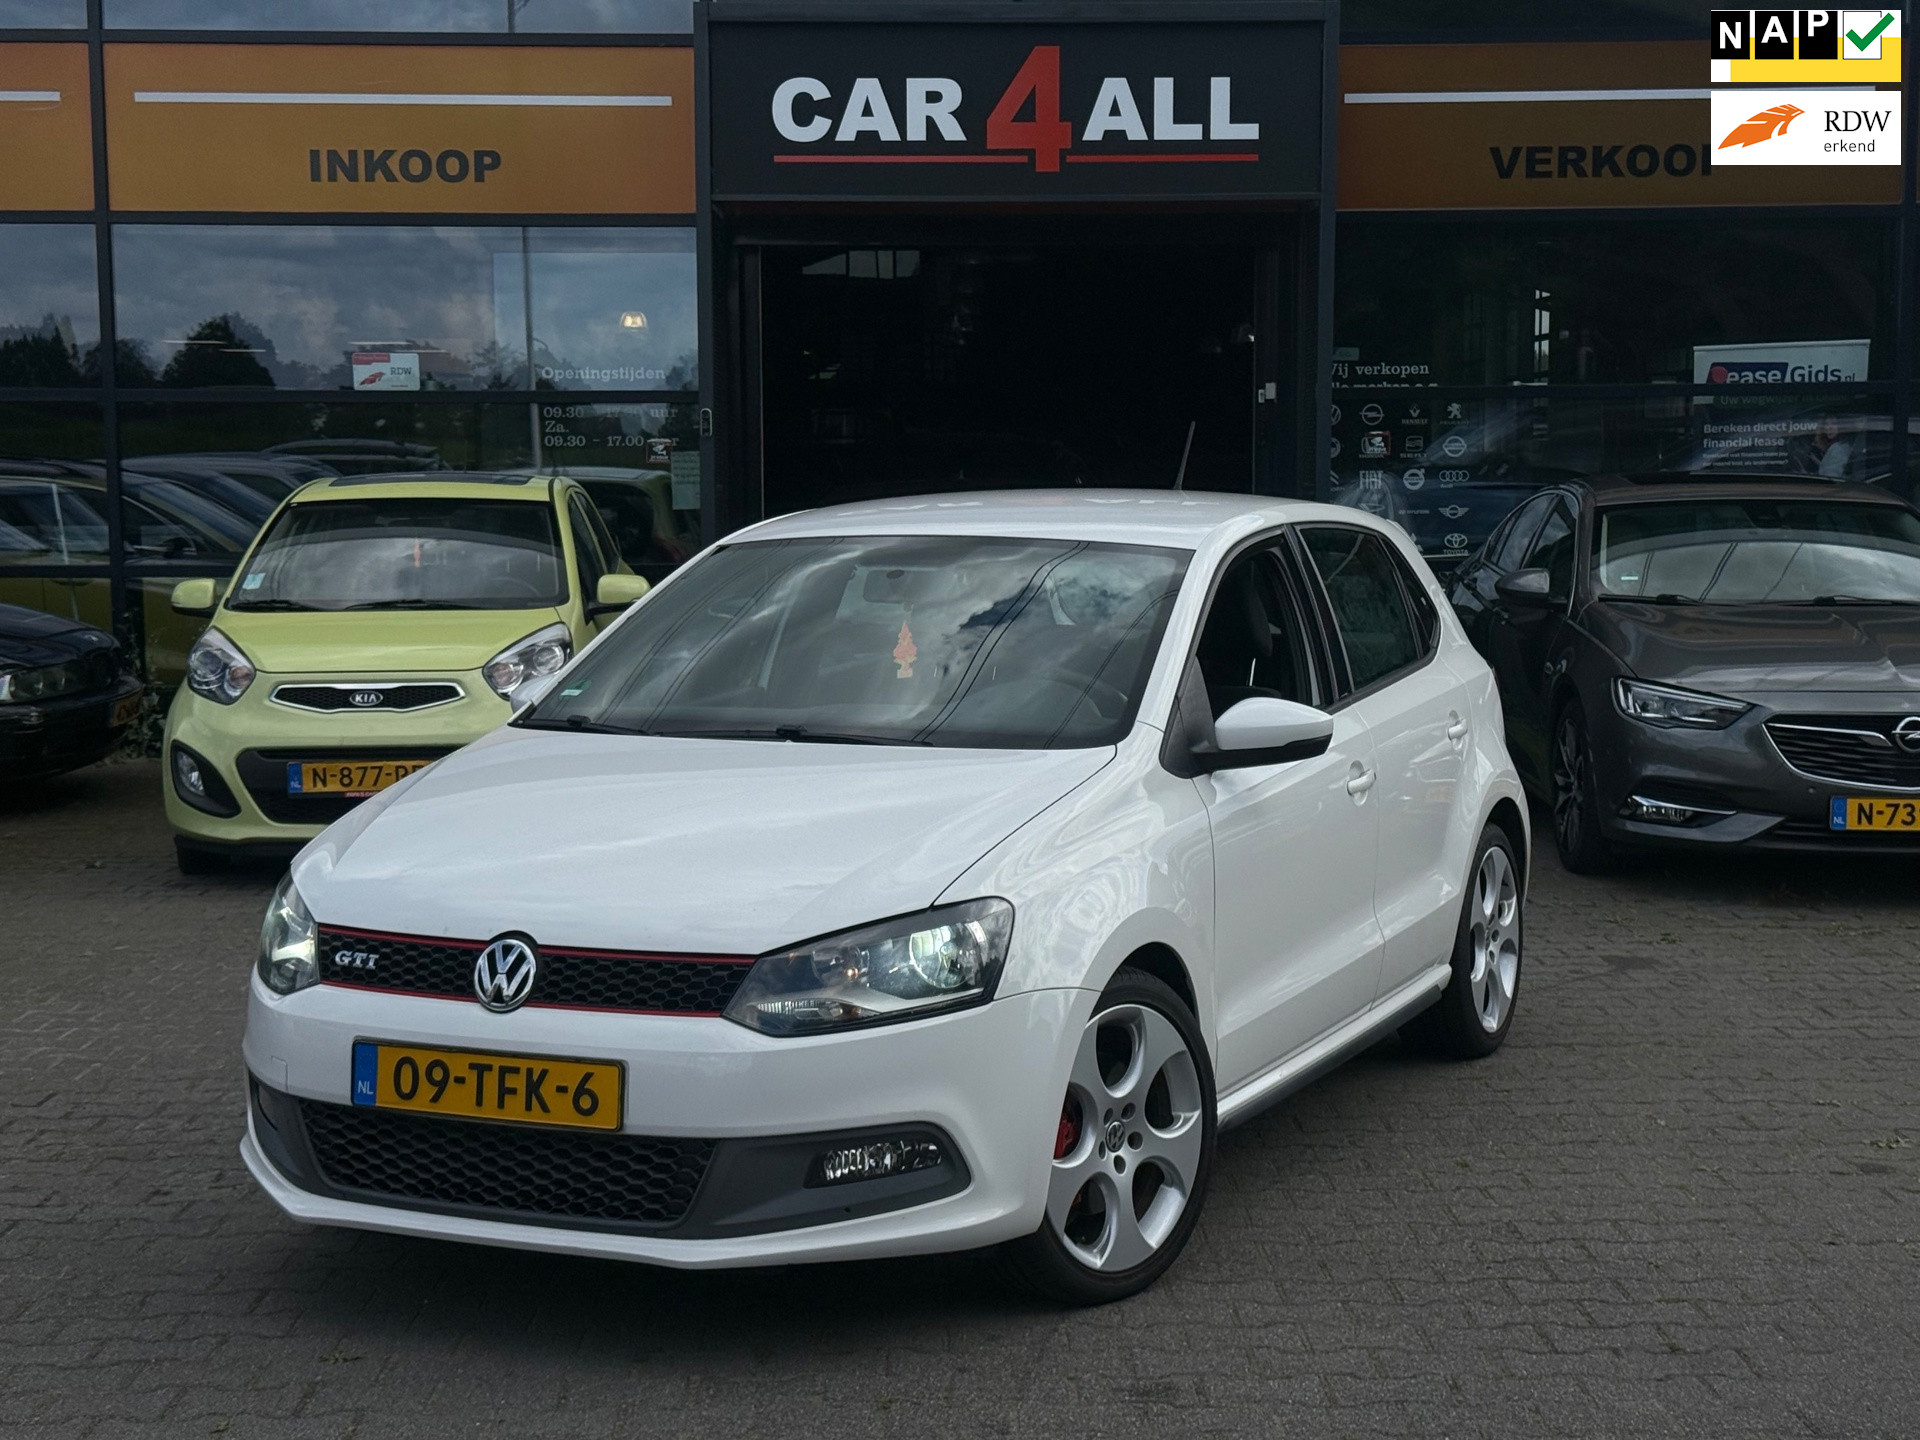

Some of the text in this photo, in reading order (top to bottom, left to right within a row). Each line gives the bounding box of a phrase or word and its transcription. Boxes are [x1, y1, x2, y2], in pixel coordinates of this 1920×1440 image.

[771, 45, 1260, 172] CAR 4 ALL
[309, 148, 502, 183] INKOOP
[390, 366, 414, 376] RDW
[541, 366, 667, 382] Openingstijden
[1355, 362, 1431, 378] verkopen
[543, 406, 585, 419] 09.30
[544, 420, 570, 433] Za.
[1703, 420, 1818, 435] Bereken direct jouw
[544, 435, 586, 447] 09.30
[606, 435, 645, 447] 17.00
[1703, 437, 1785, 449] financial lease
[355, 693, 378, 703] KIA
[1833, 802, 1920, 826] NL N-73
[334, 950, 381, 970] GTI
[357, 1056, 601, 1117] NL 09-TFK-6
